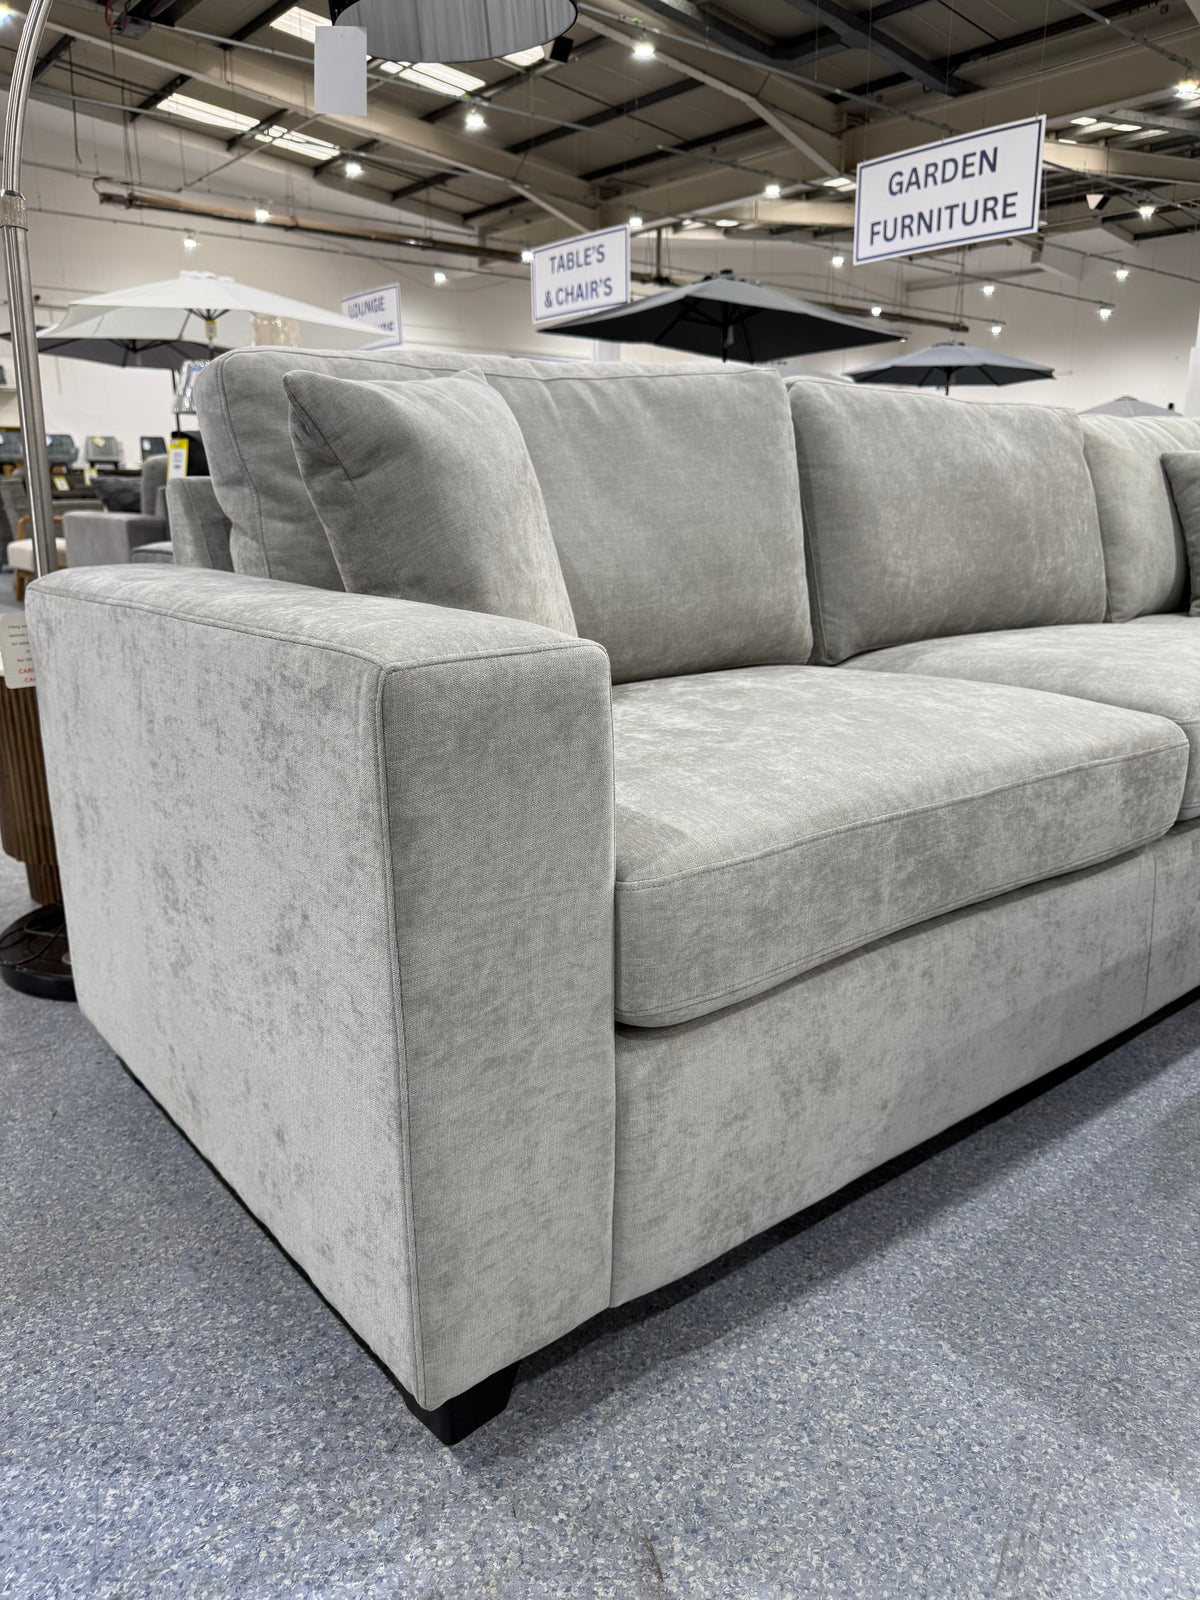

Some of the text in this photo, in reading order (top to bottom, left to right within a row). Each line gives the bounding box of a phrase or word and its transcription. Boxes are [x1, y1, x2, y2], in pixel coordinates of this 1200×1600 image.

[888, 146, 998, 196] GARDEN
[869, 191, 1018, 246] FURNITURE
[549, 243, 605, 275] TABLE'S
[544, 277, 613, 309] & CHAIR'S
